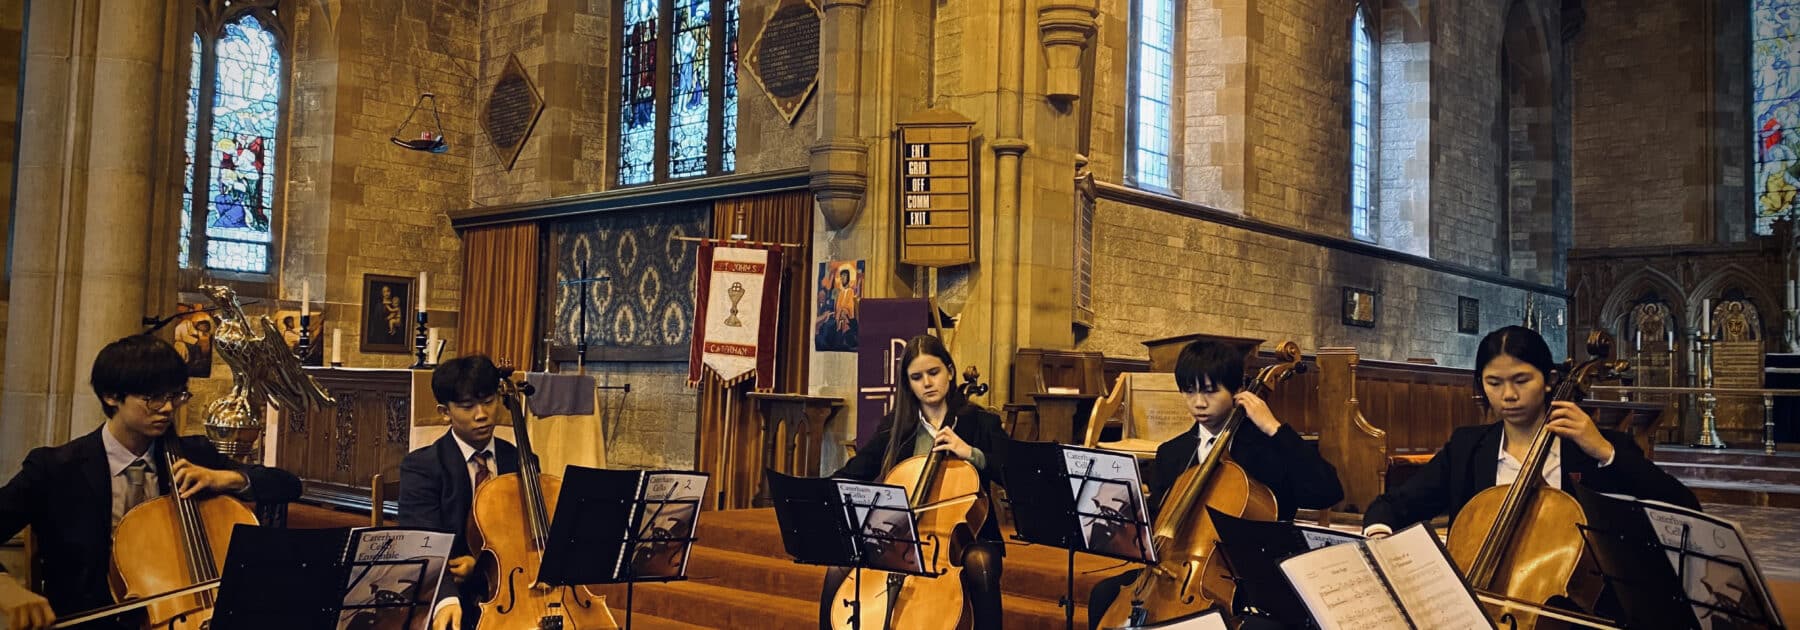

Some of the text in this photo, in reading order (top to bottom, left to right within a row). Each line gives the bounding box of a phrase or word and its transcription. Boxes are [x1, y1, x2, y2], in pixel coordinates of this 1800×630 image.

[911, 144, 925, 158] ENT
[908, 161, 927, 175] GRID
[911, 178, 925, 192] OFF
[907, 195, 930, 209] COMM
[910, 211, 927, 225] EXIT
[1074, 461, 1090, 470] Cell
[1111, 460, 1121, 473] 4
[684, 479, 691, 490] 2
[884, 489, 893, 500] 3
[362, 532, 405, 542] Caterham
[421, 536, 432, 548] 1
[1712, 527, 1726, 549] 6
[358, 552, 400, 561] Ensble
